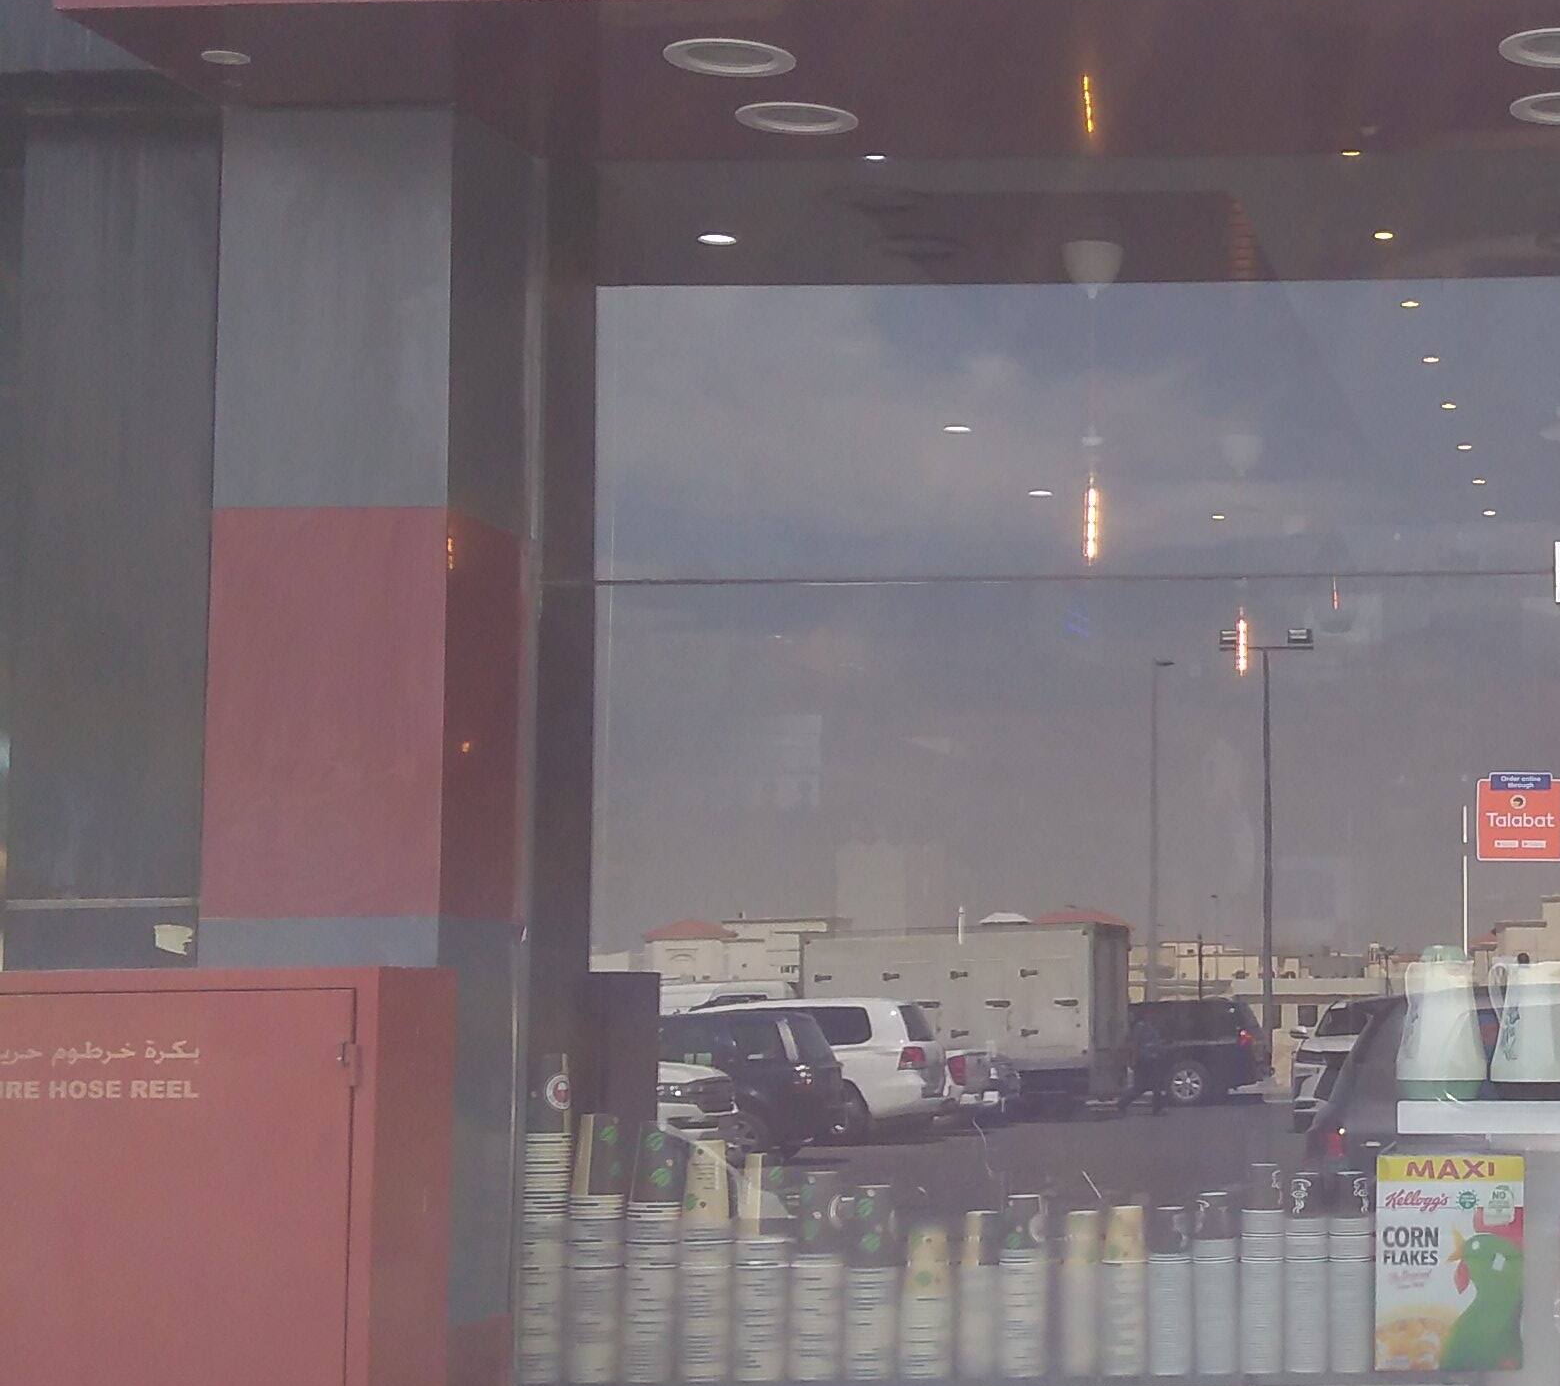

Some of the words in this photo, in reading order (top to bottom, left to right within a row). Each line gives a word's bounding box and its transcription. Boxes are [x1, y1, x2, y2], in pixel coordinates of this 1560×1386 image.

[1485, 812, 1555, 827] Talabat
[51, 1040, 136, 1067] خرطوم
[144, 1039, 201, 1065] بكرة
[50, 1079, 122, 1099] HOSE
[130, 1079, 200, 1100] REEL
[1405, 1159, 1496, 1180] MAXI
[1385, 1189, 1450, 1213] Kellogg's
[1382, 1225, 1440, 1249] CORN
[1382, 1249, 1439, 1267] FLAKES
